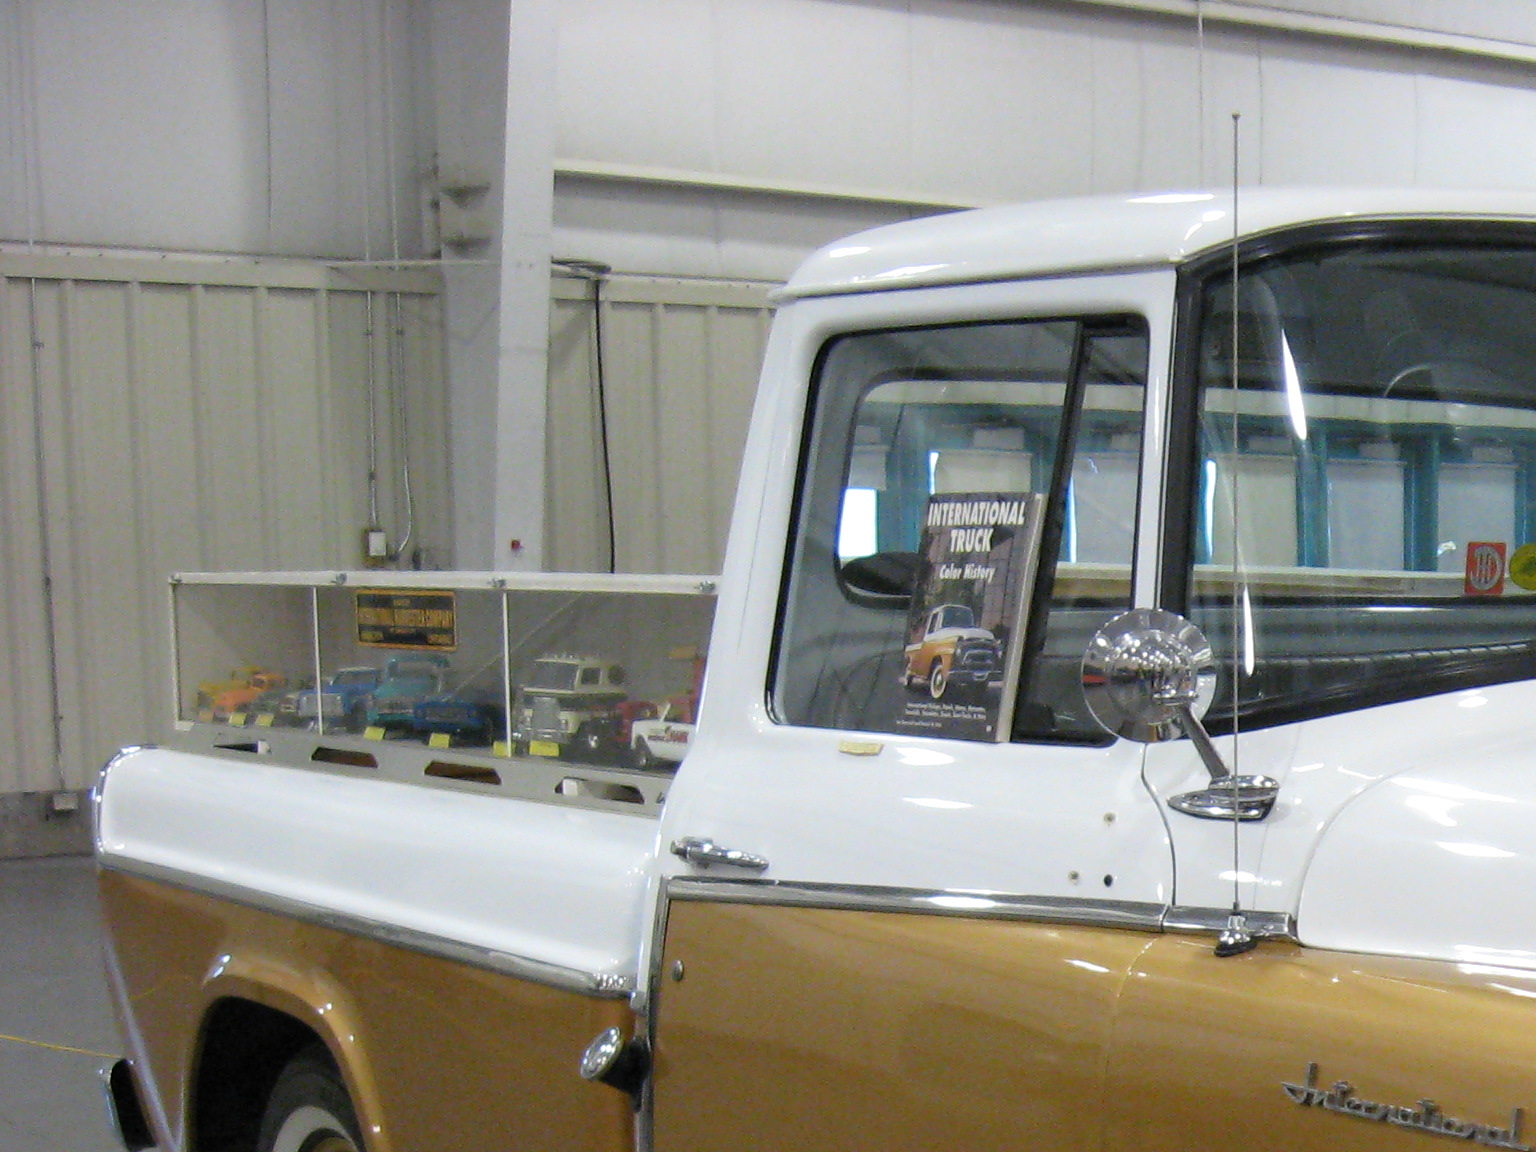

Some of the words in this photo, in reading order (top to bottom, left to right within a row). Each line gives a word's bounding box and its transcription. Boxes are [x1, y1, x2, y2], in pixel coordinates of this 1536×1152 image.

[927, 501, 1026, 527] INTERNATIONAL
[950, 528, 994, 553] TRUCK
[940, 563, 962, 579] Color
[963, 563, 996, 583] History
